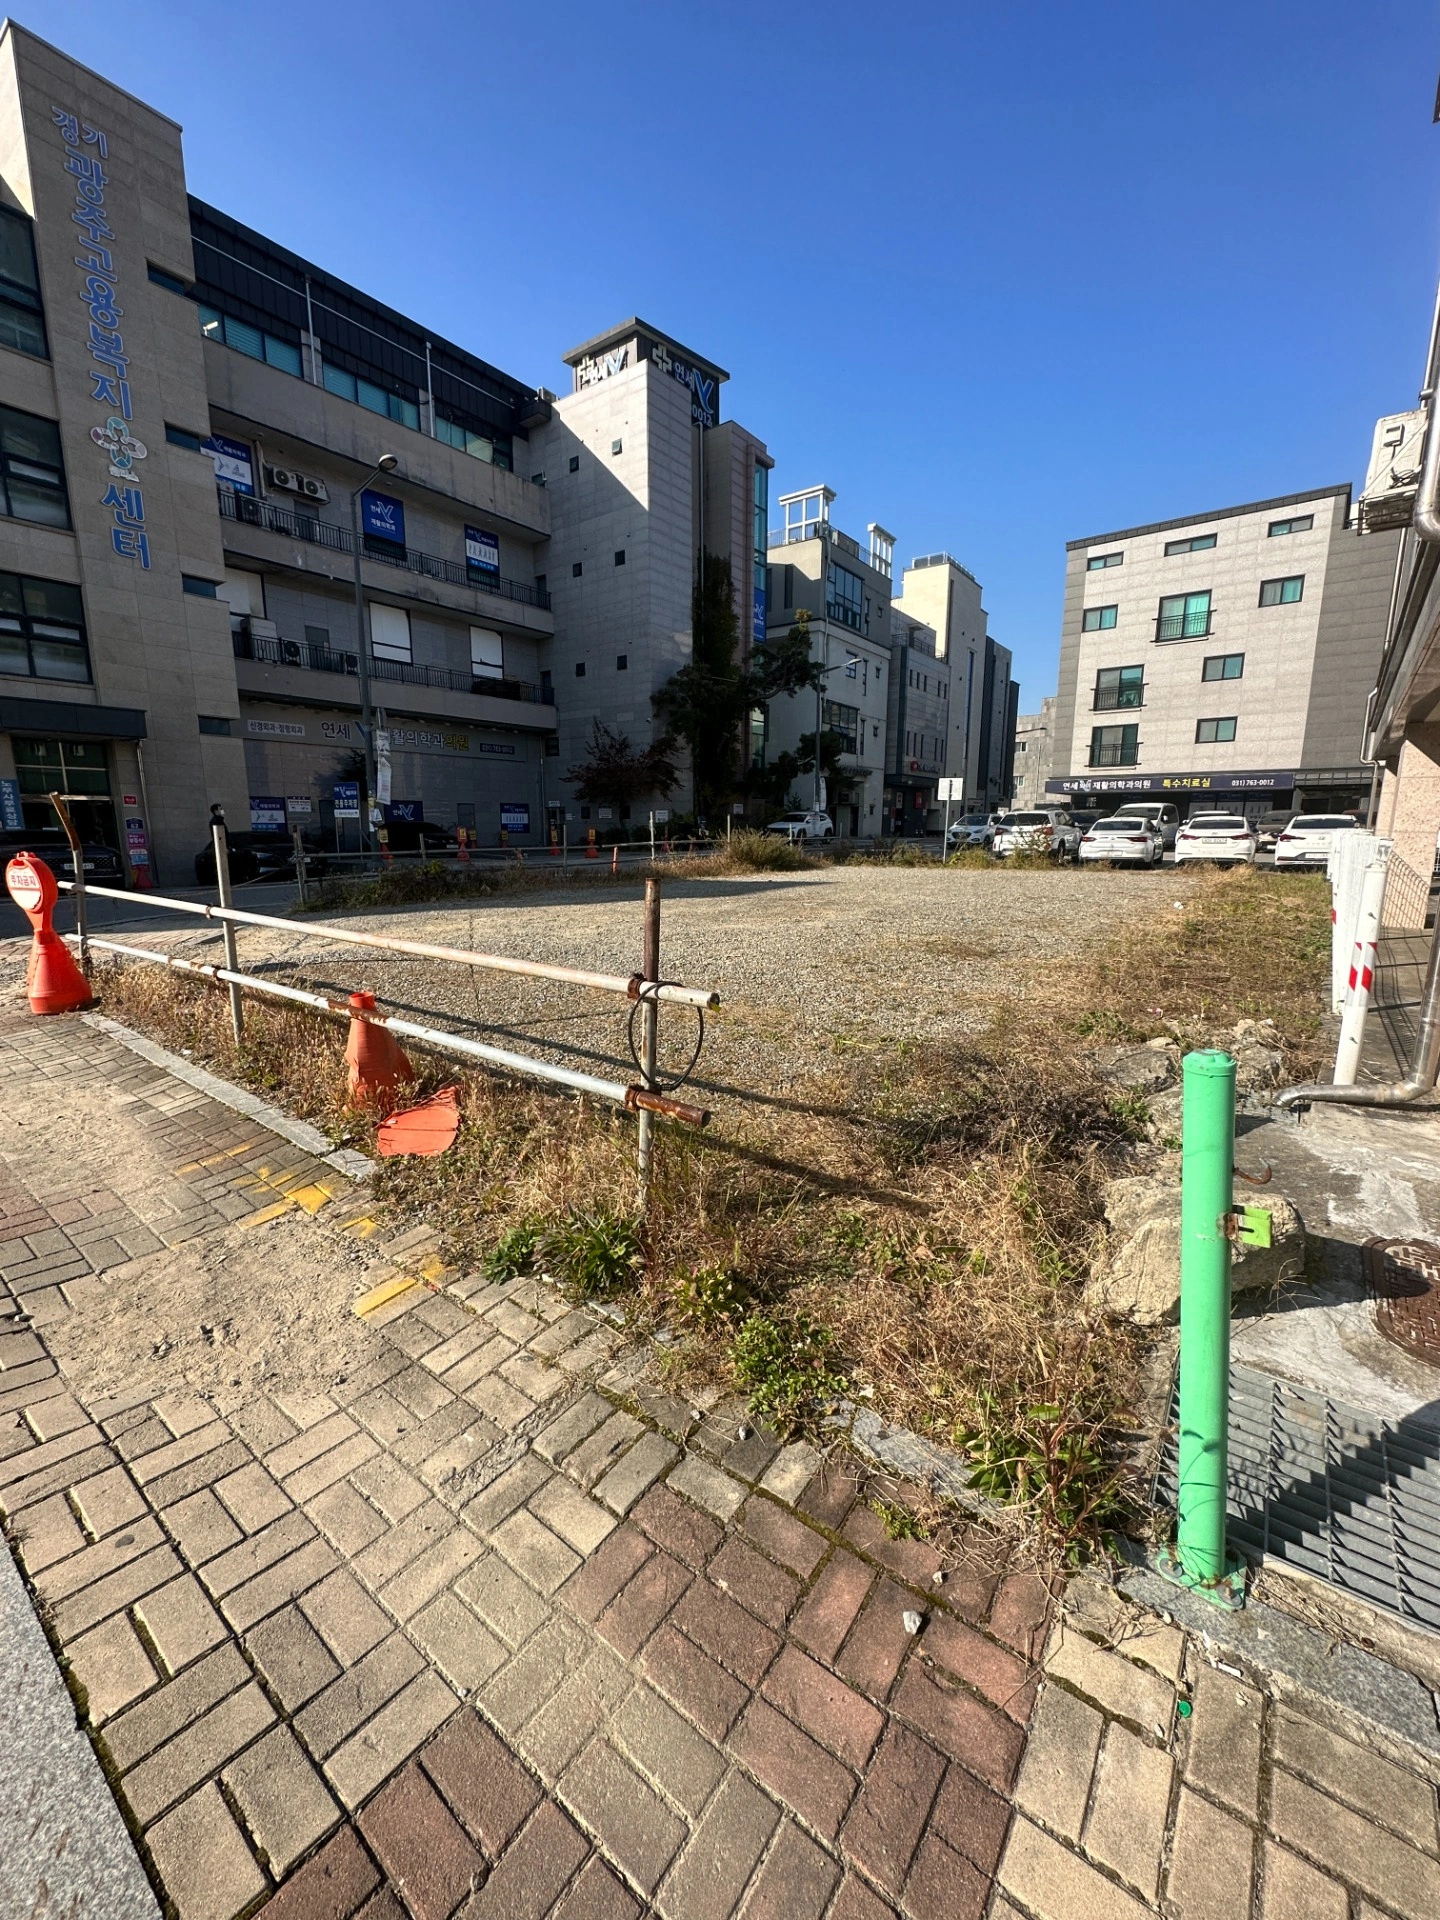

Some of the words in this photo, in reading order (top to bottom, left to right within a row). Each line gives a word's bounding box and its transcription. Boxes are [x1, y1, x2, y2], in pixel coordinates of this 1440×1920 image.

[51, 105, 108, 159] 경기
[63, 145, 133, 421] 광주고용복지
[674, 361, 696, 393] 연세
[101, 483, 151, 570] 센터
[321, 721, 352, 741] 연세
[379, 726, 470, 751] 활의학과의원
[1162, 777, 1211, 788] 특수치료실
